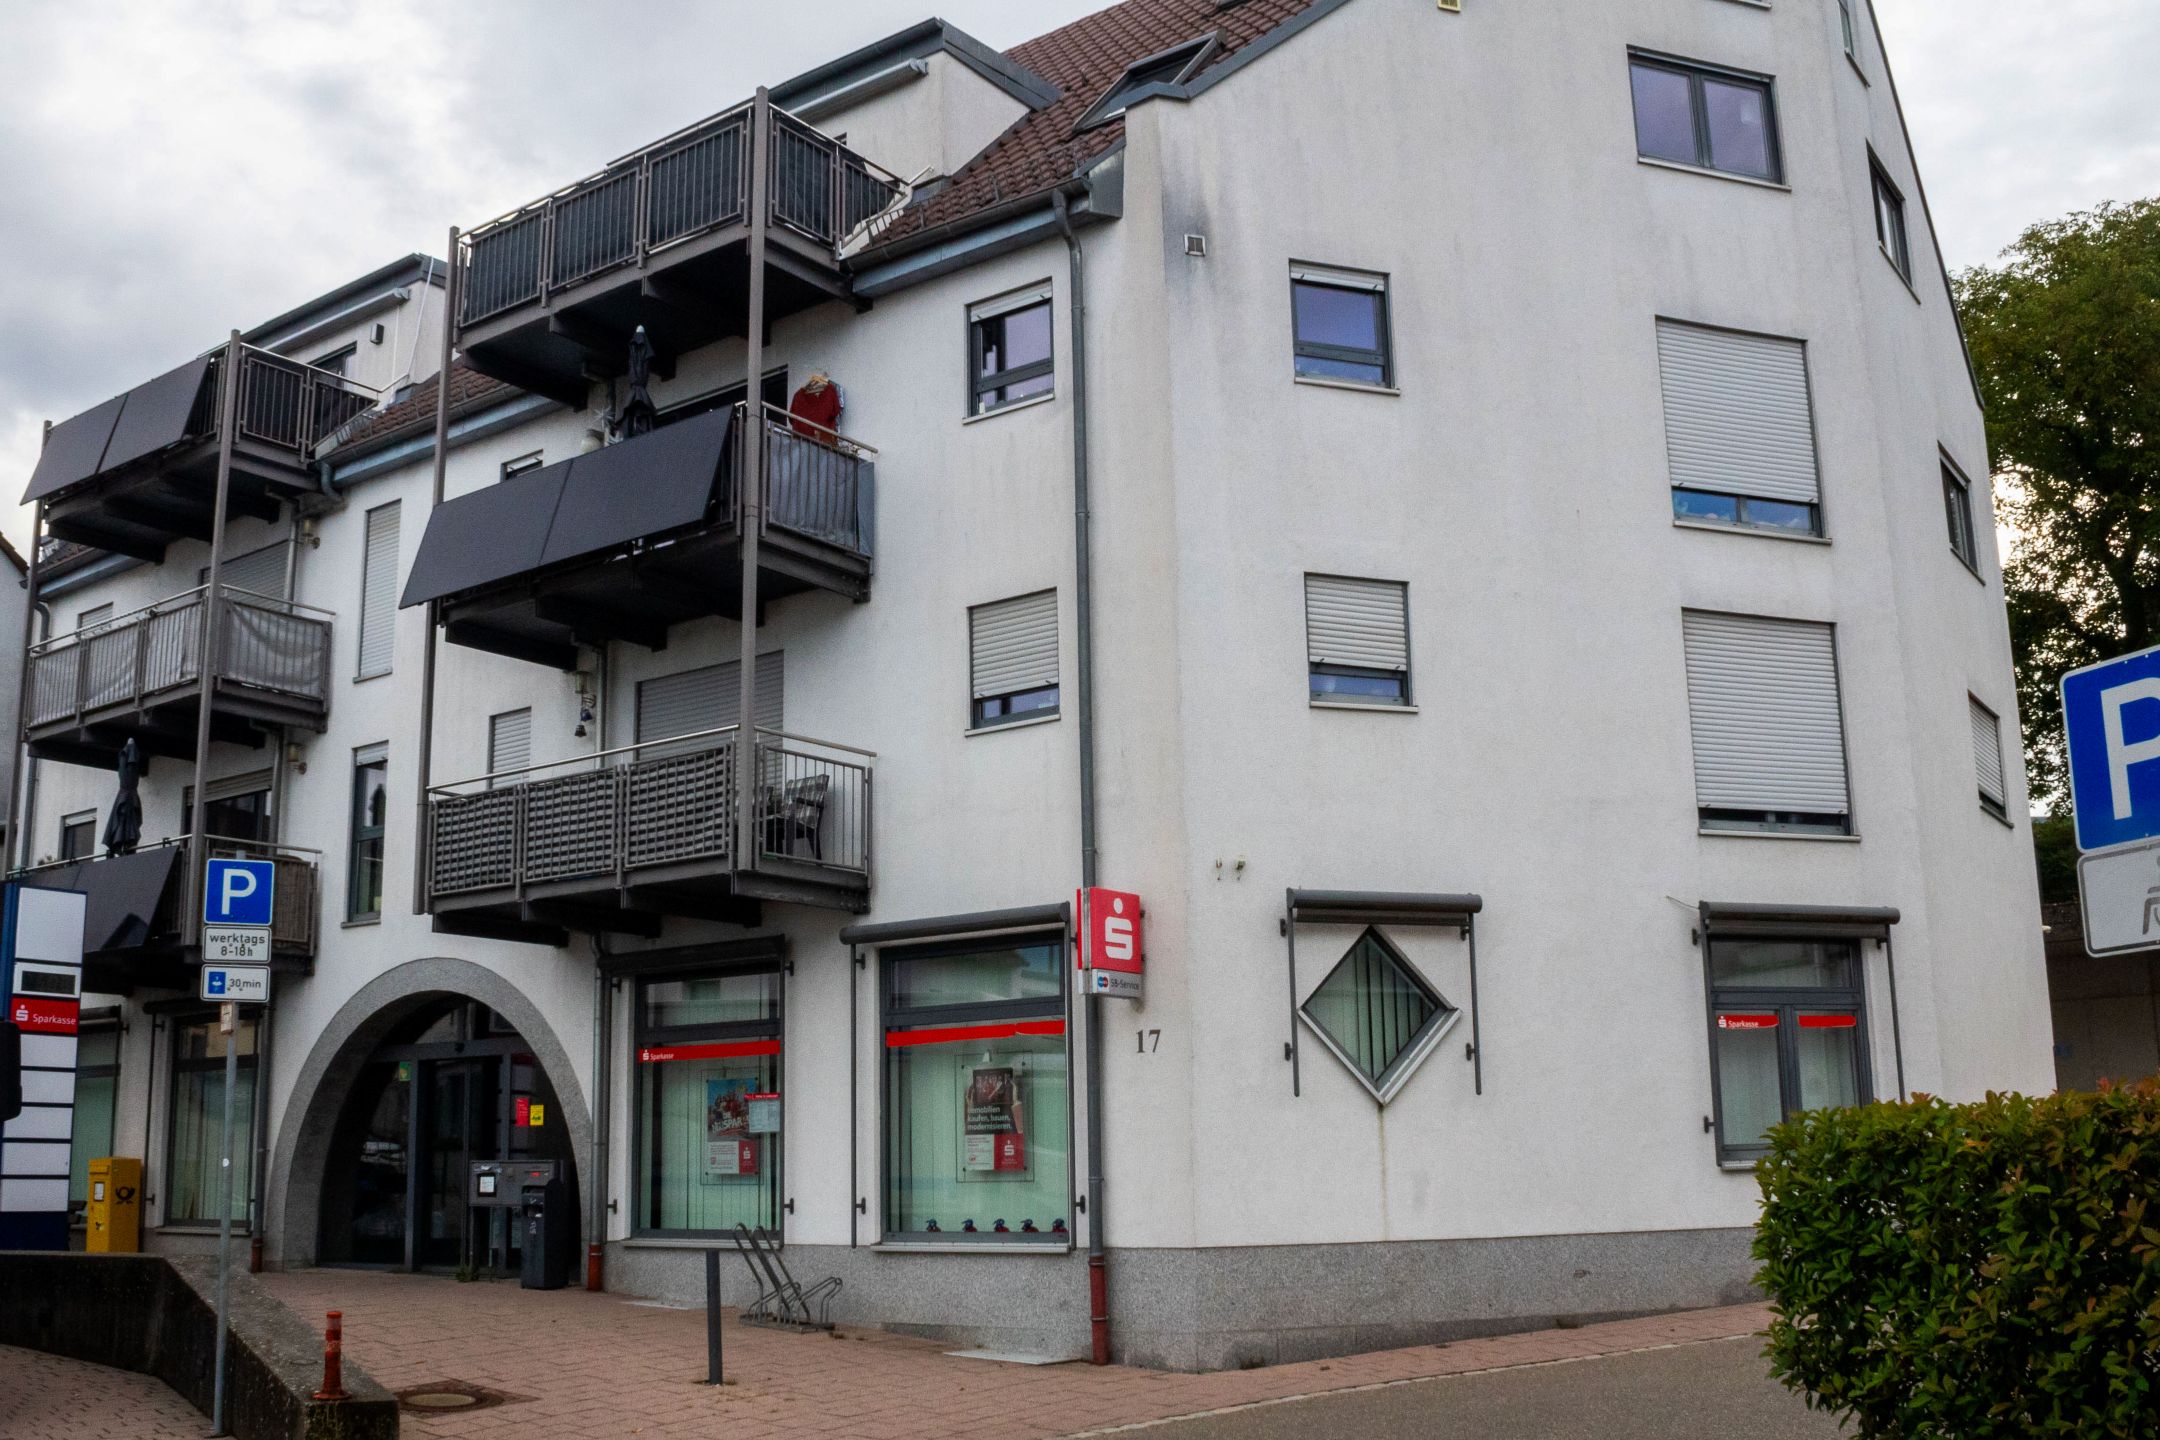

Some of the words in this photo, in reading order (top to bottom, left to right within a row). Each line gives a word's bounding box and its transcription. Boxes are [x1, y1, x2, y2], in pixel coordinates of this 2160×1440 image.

[2100, 677, 2160, 820] P
[221, 868, 257, 915] P
[209, 933, 266, 946] werktags
[229, 978, 241, 988] 30
[242, 979, 262, 988] min
[1110, 978, 1140, 990] SB-Service
[32, 1013, 77, 1025] Sparkasse
[1728, 1020, 1759, 1028] Sparkasse
[1135, 1029, 1161, 1053] 17
[650, 1052, 674, 1061] Sparkasse
